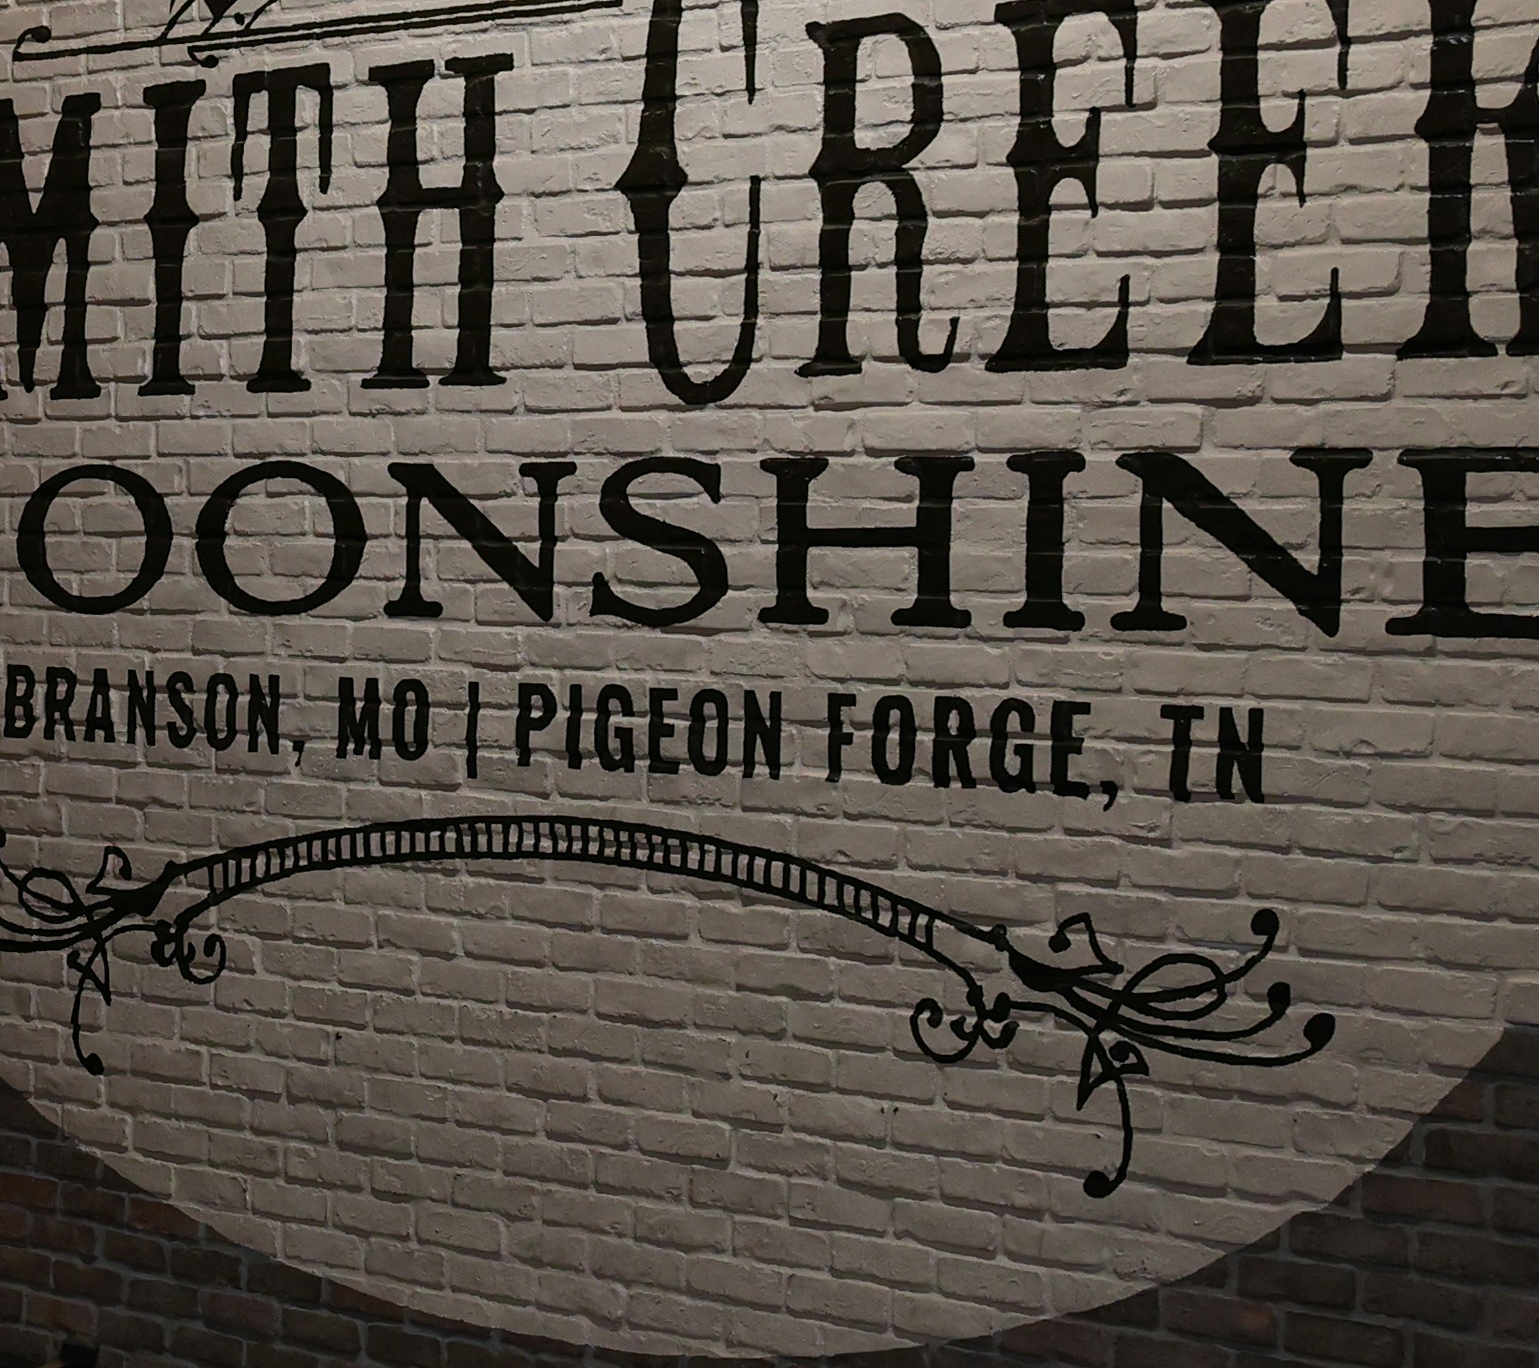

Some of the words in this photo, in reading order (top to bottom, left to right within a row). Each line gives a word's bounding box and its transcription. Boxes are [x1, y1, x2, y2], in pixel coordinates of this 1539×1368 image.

[2, 665, 305, 767] BRANSON,
[336, 676, 431, 760] MO
[515, 682, 784, 782] PIGEON
[824, 693, 1118, 811] FORGE,
[1162, 703, 1265, 805] TN
